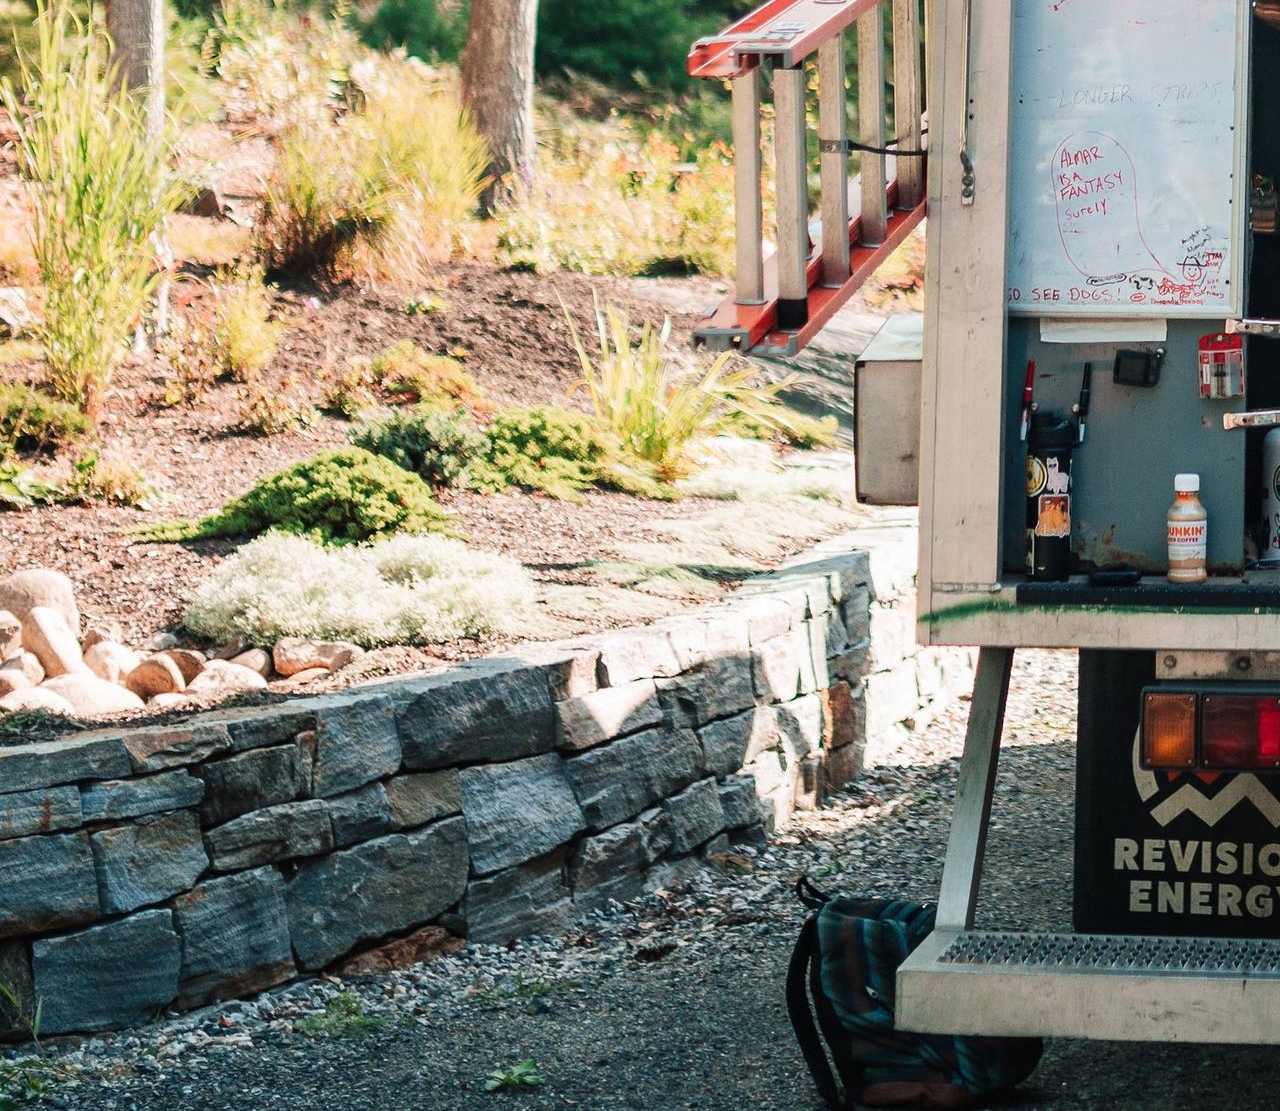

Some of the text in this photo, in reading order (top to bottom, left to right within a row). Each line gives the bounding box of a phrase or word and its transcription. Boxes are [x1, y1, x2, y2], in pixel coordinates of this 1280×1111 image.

[1061, 146, 1104, 168] ALMAR
[1060, 170, 1122, 200] FANTASY
[1032, 288, 1060, 301] SEE
[1168, 526, 1204, 536] UNKIN'
